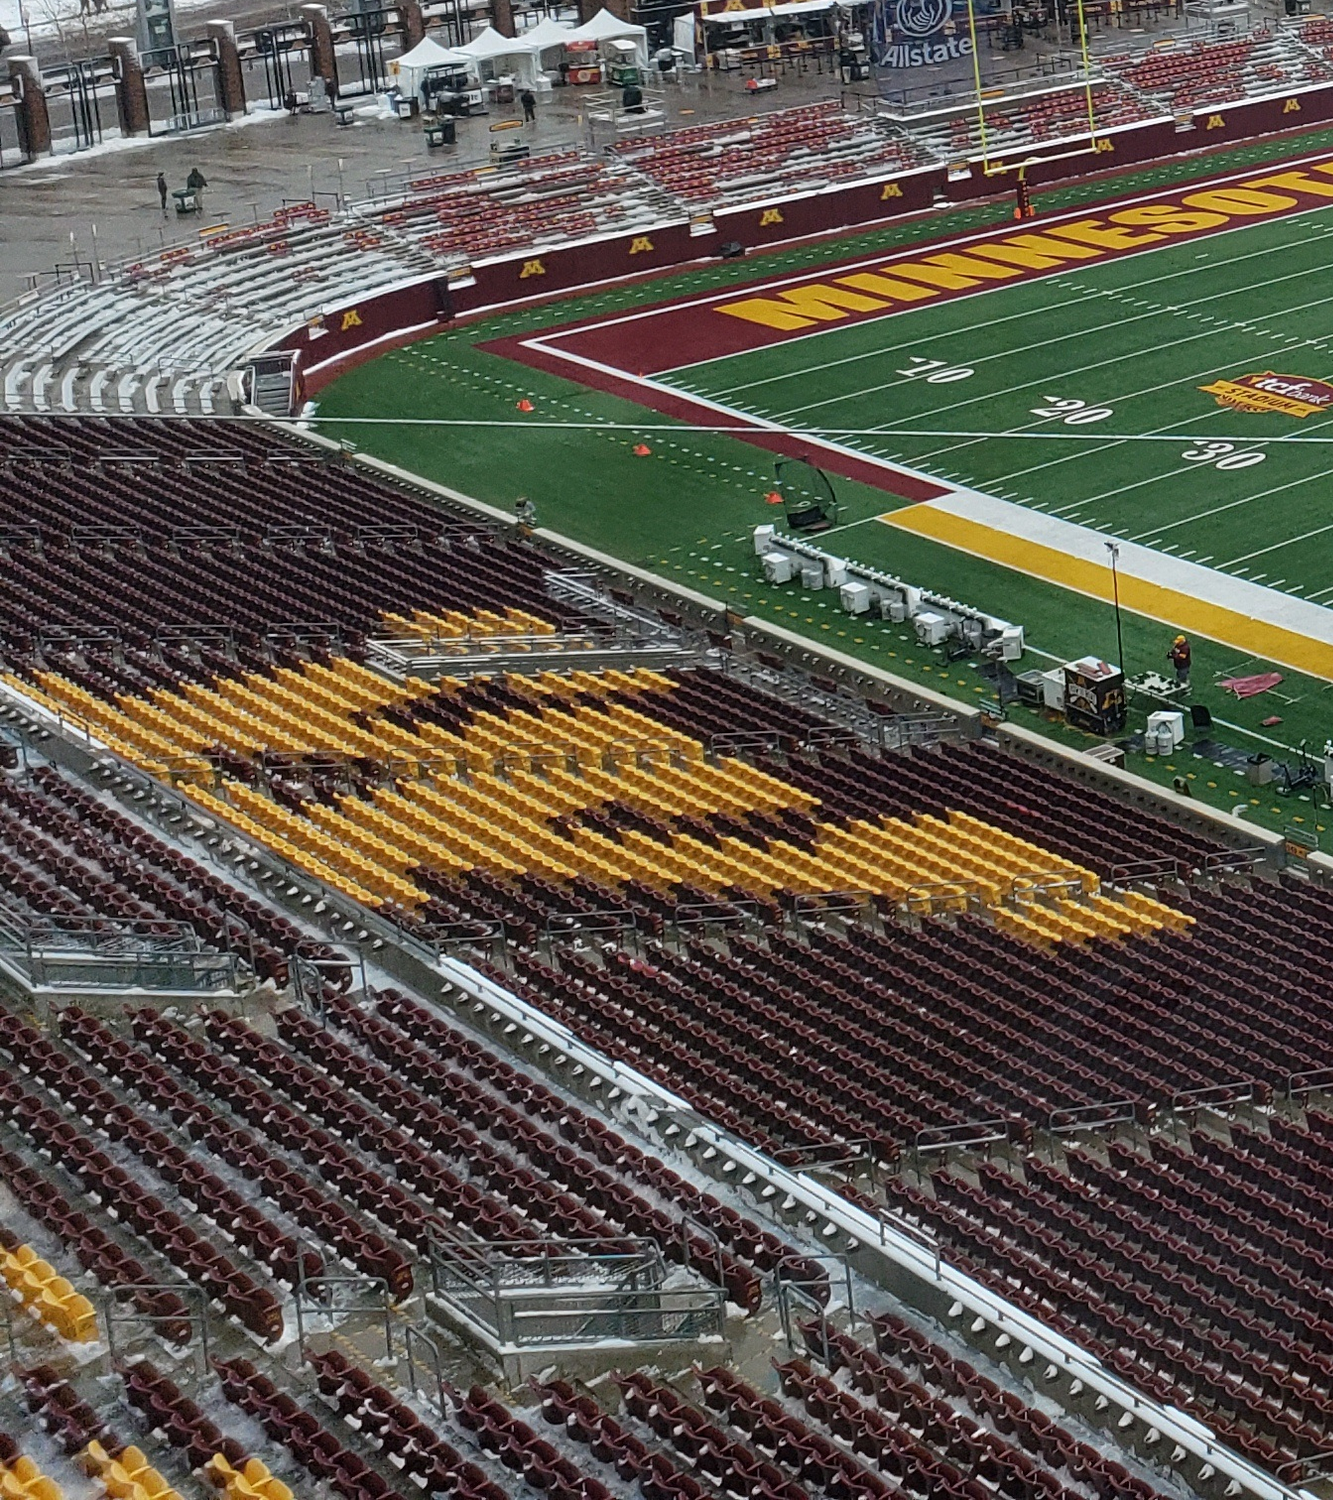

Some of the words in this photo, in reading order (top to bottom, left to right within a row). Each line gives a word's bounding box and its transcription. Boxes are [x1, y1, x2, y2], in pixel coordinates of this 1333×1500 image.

[880, 36, 974, 68] Allstate
[898, 359, 976, 384] 10
[1030, 397, 1114, 425] 20
[1224, 387, 1299, 411] STADIUM
[1181, 443, 1267, 470] 30
